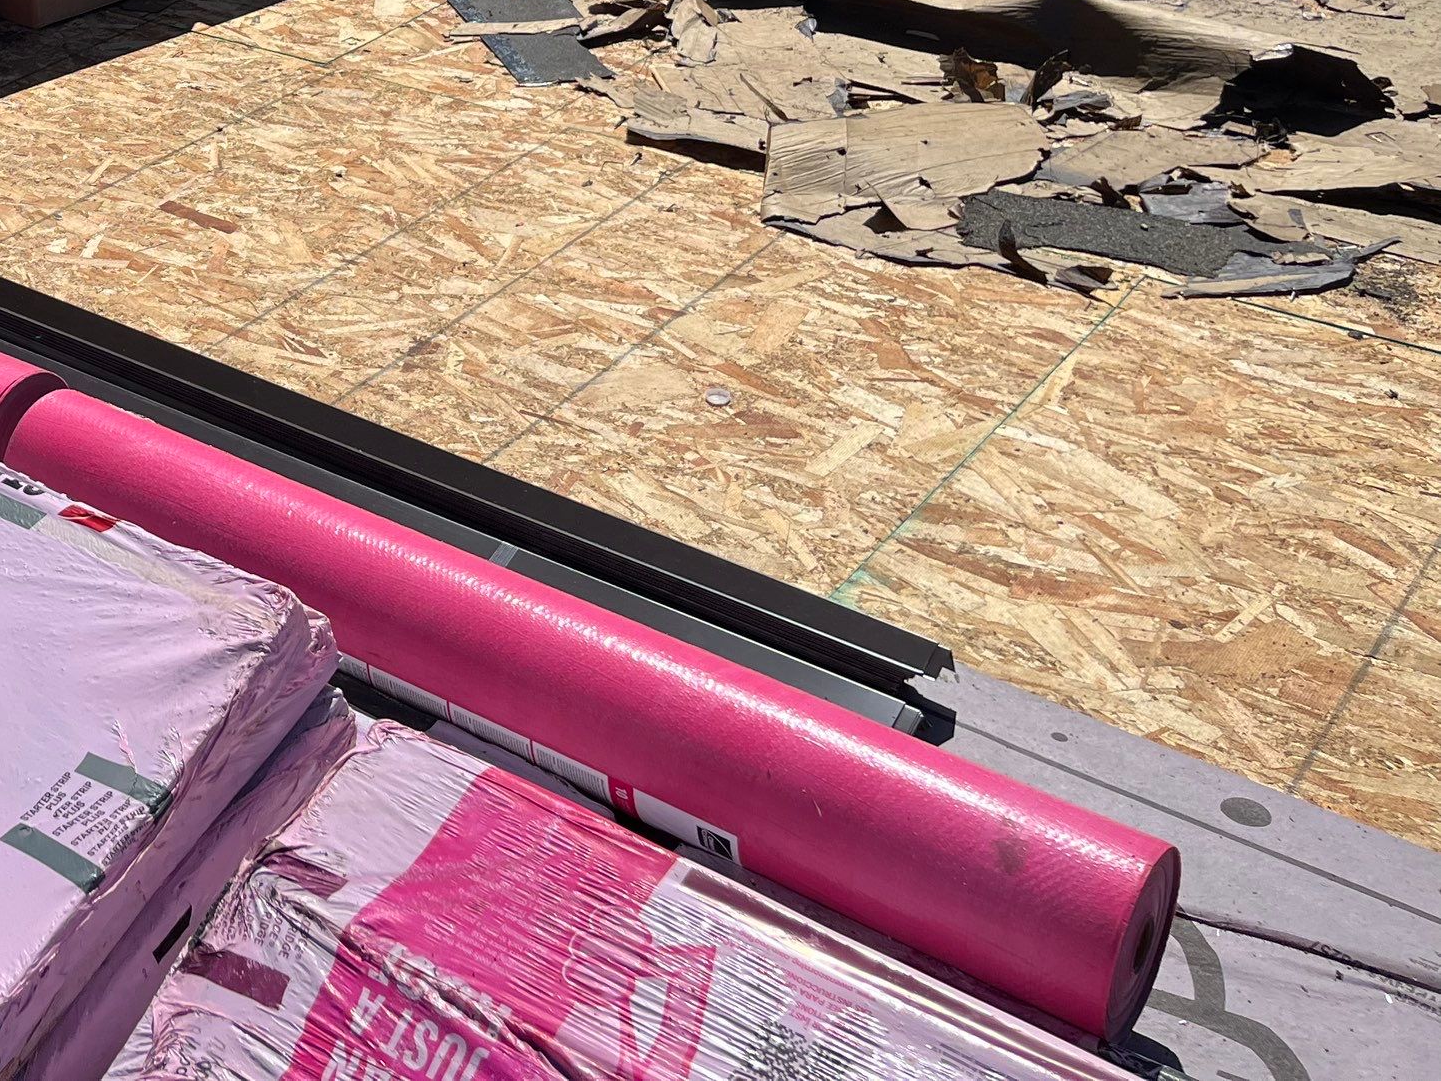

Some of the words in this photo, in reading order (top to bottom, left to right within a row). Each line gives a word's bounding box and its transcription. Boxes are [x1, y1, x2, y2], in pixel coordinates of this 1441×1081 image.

[20, 791, 54, 821] STARTER
[50, 771, 71, 793] STRIP
[45, 791, 67, 811] PLUS
[70, 781, 93, 801] STRIP
[52, 810, 92, 837] STARTER
[89, 790, 113, 811] STRIP
[62, 801, 85, 820] PLUS
[80, 809, 106, 827] PLUS
[109, 798, 132, 820] STRIP
[87, 824, 120, 857] STARTER
[101, 833, 130, 866] STARTER
[254, 911, 272, 946] RIDGE
[277, 925, 298, 959] RIDGE
[349, 986, 387, 1034] A
[377, 1010, 490, 1081] JUST
